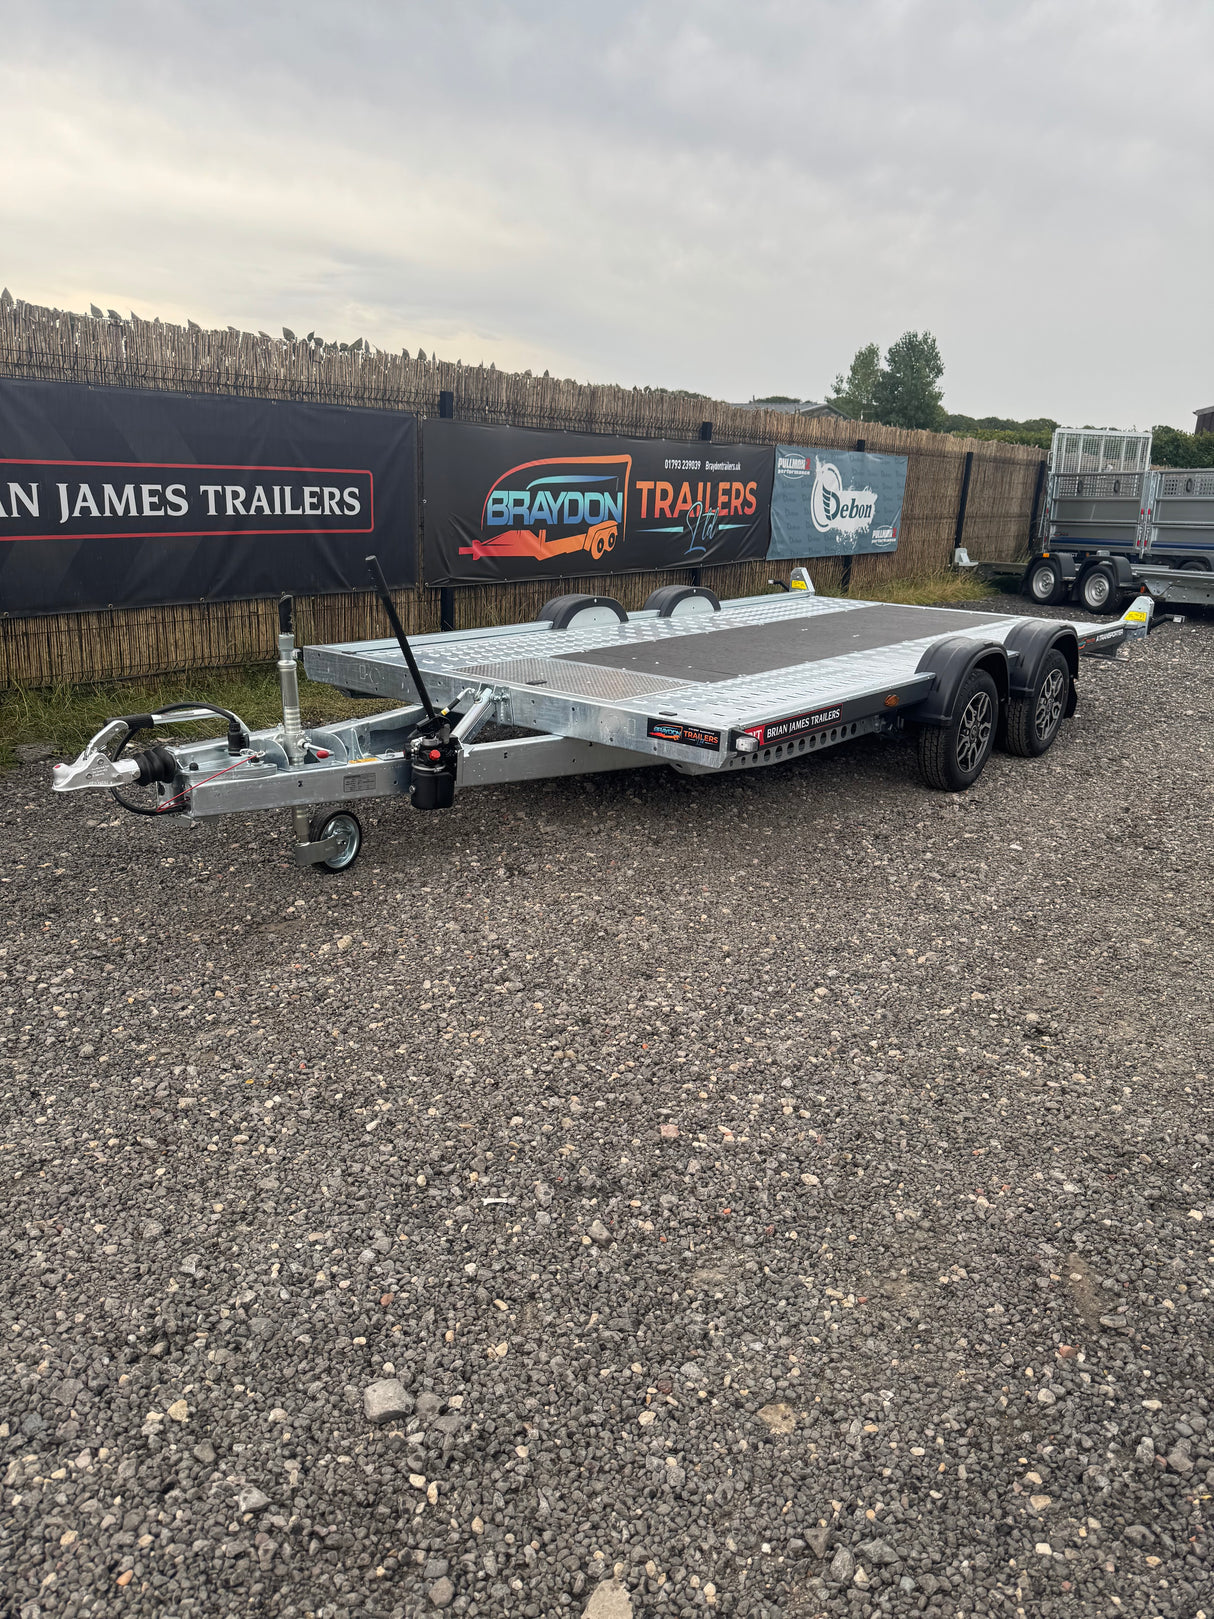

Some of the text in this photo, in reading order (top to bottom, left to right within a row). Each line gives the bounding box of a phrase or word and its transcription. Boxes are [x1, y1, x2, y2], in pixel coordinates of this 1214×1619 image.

[664, 459, 681, 469] 01793
[55, 482, 189, 523] JAMES
[199, 484, 361, 516] TRAILERS
[486, 481, 758, 526] BRAYDON TRAILERS
[822, 485, 873, 521] Debon
[684, 501, 719, 555] Ltd
[683, 730, 719, 744] TRAILERS
[766, 723, 788, 739] BRIAN
[788, 717, 810, 733] JAMES
[810, 708, 841, 725] TRAILERS
